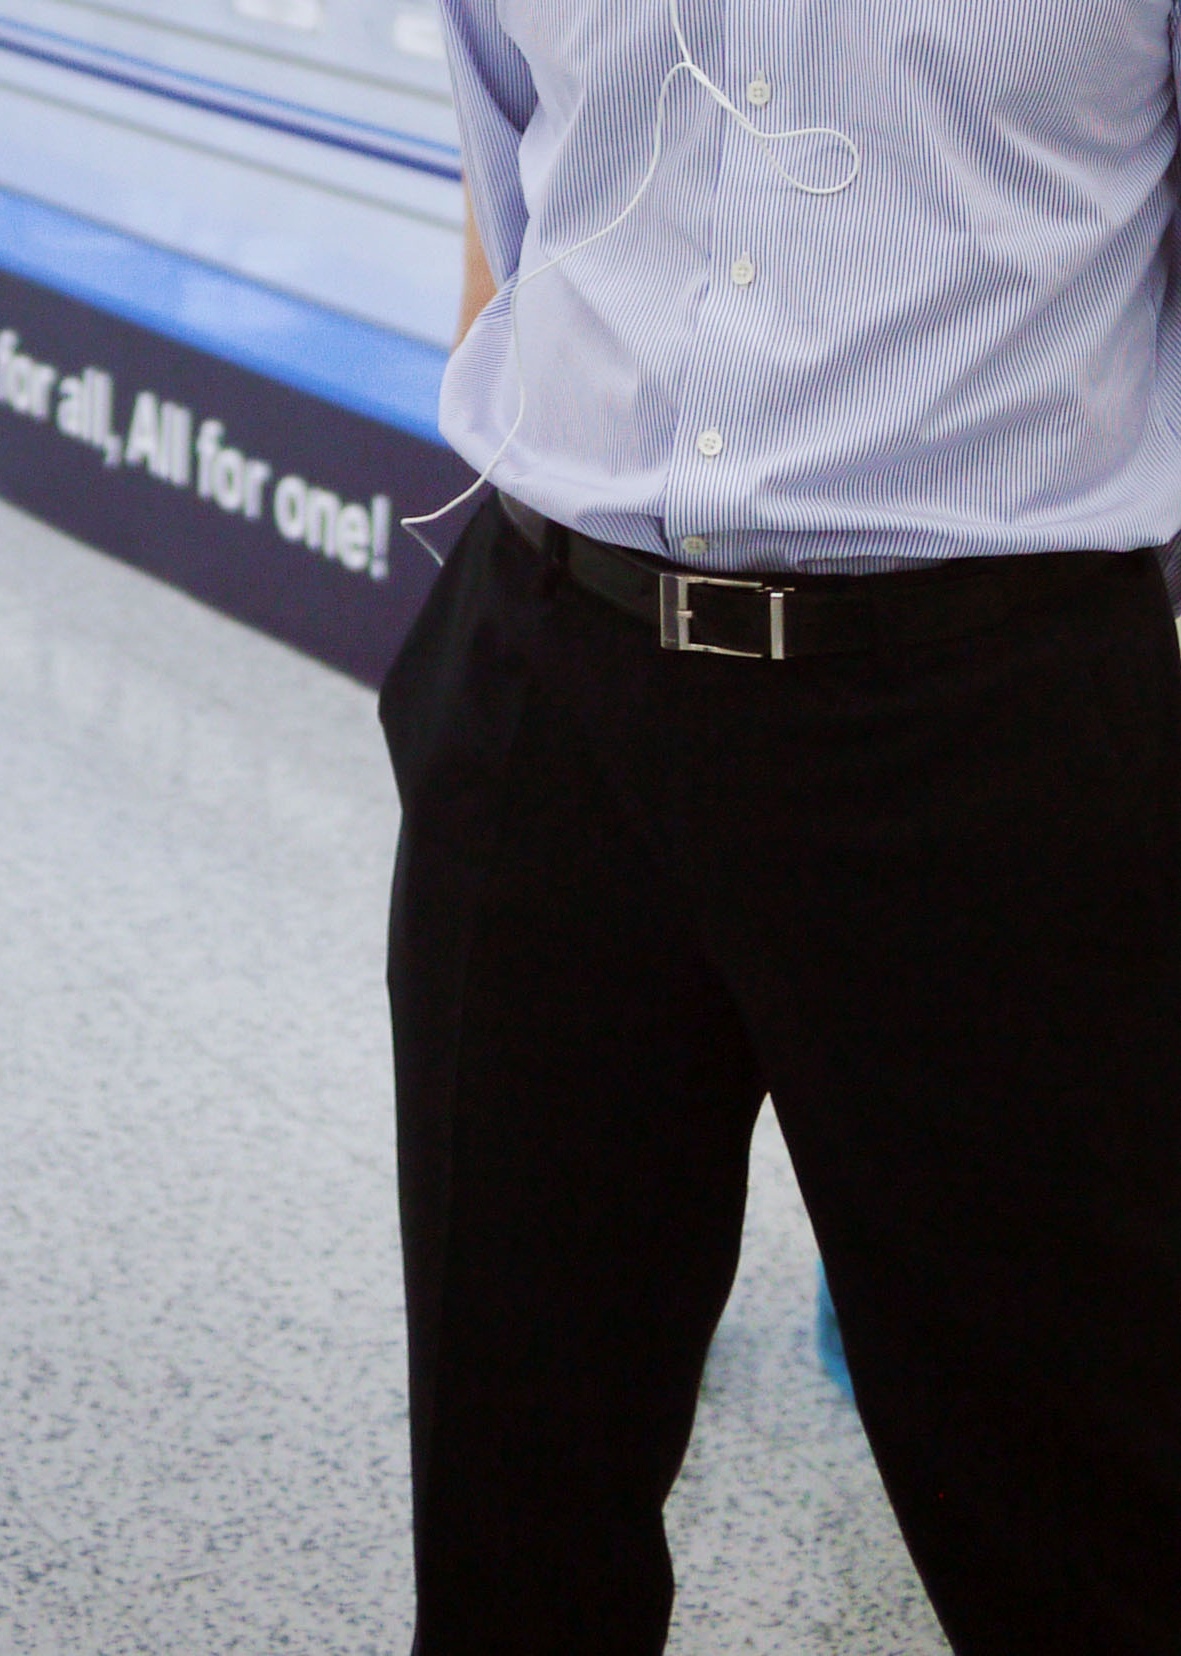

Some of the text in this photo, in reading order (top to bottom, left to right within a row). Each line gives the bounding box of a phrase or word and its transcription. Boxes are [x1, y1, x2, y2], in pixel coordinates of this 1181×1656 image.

[56, 365, 122, 468] all,
[124, 391, 192, 488] All
[196, 418, 273, 522] for
[274, 474, 392, 581] one!
